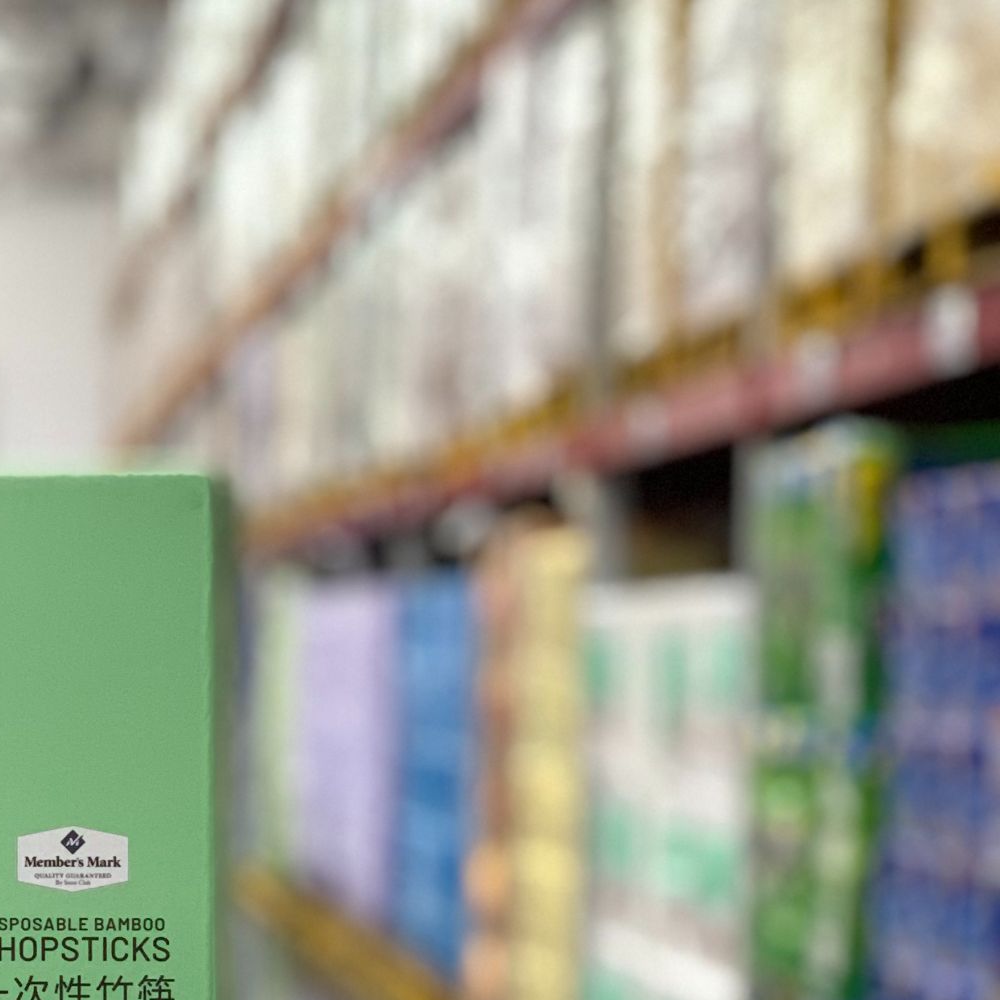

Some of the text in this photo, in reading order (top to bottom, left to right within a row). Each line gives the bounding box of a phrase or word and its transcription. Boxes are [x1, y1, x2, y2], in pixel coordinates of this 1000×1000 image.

[24, 855, 122, 868] Member's Mark
[34, 872, 64, 880] QUALITY
[94, 917, 166, 931] BAMBOO
